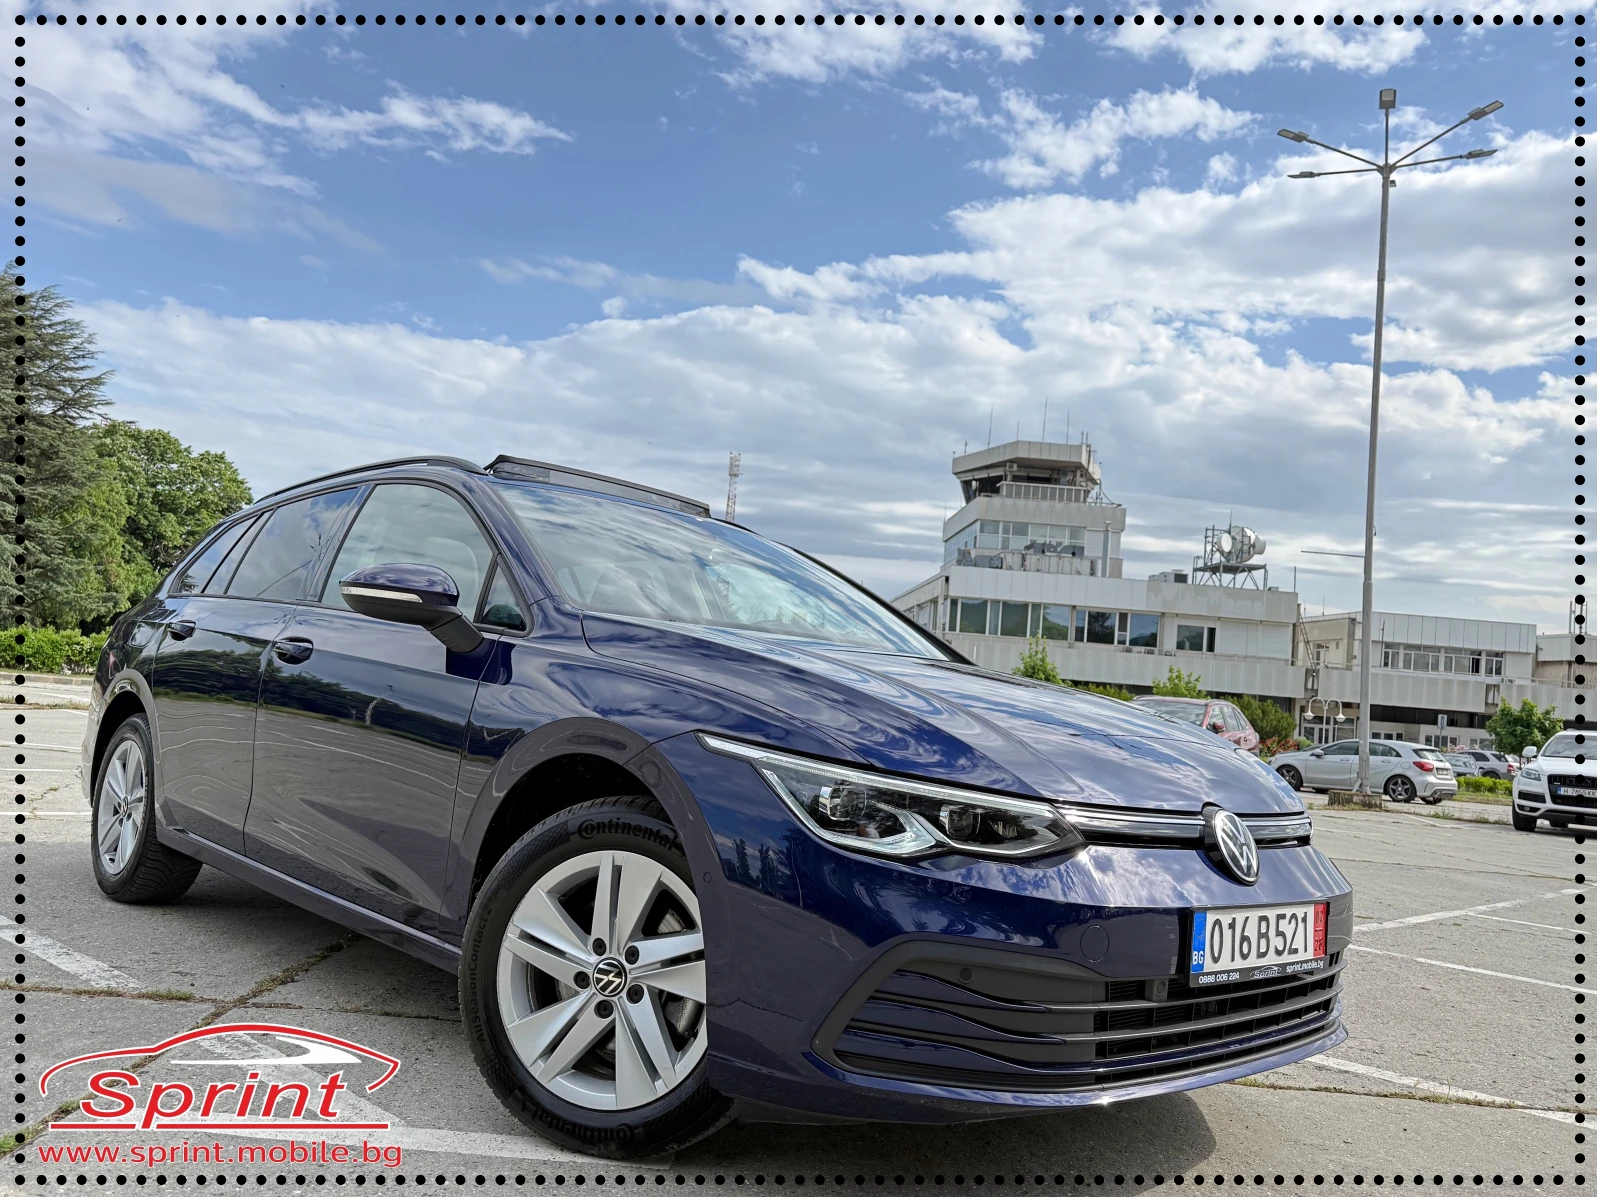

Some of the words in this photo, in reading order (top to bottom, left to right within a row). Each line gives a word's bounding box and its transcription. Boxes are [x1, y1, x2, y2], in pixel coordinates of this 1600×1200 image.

[577, 817, 679, 851] Continental
[1210, 911, 1308, 964] 016B521
[1192, 950, 1204, 965] BG
[1253, 969, 1279, 979] Sprint
[1286, 960, 1325, 974] sprint.mobile.bg
[468, 918, 488, 1042] AllSeasonContact
[1198, 974, 1215, 984] 0888
[1216, 972, 1228, 982] 006
[1229, 971, 1240, 980] 224
